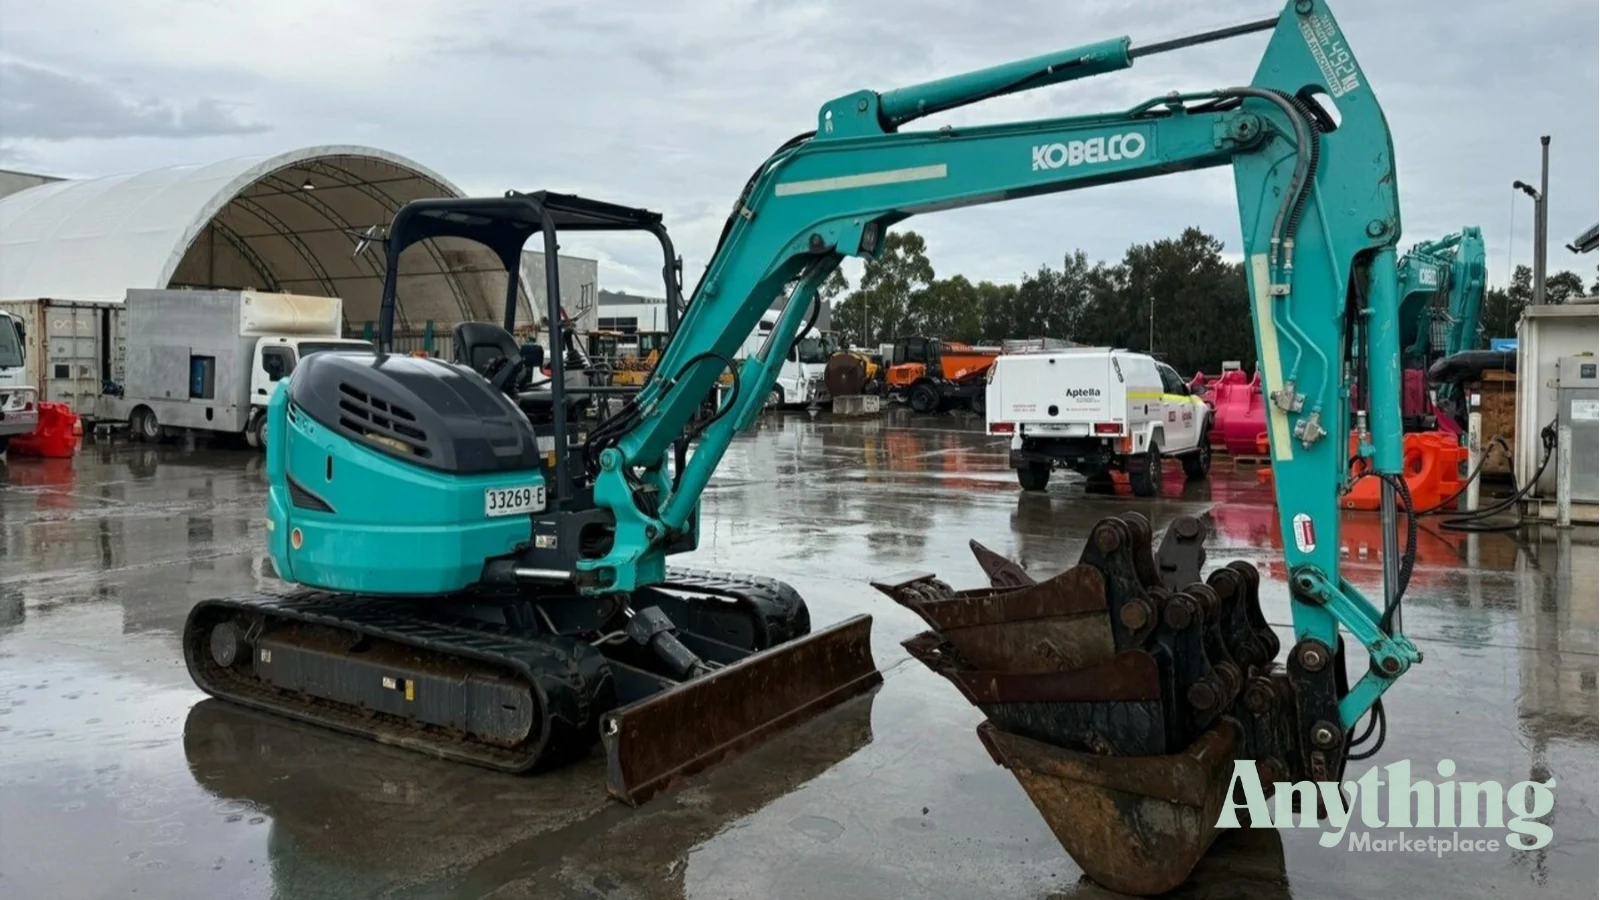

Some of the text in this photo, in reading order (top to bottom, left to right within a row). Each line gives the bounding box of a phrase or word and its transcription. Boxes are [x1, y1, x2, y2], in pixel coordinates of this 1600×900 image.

[1309, 40, 1341, 95] ATTACHMENTS
[1328, 40, 1356, 77] 492
[1032, 132, 1146, 171] KOBELCO
[1065, 388, 1101, 399] Aptella
